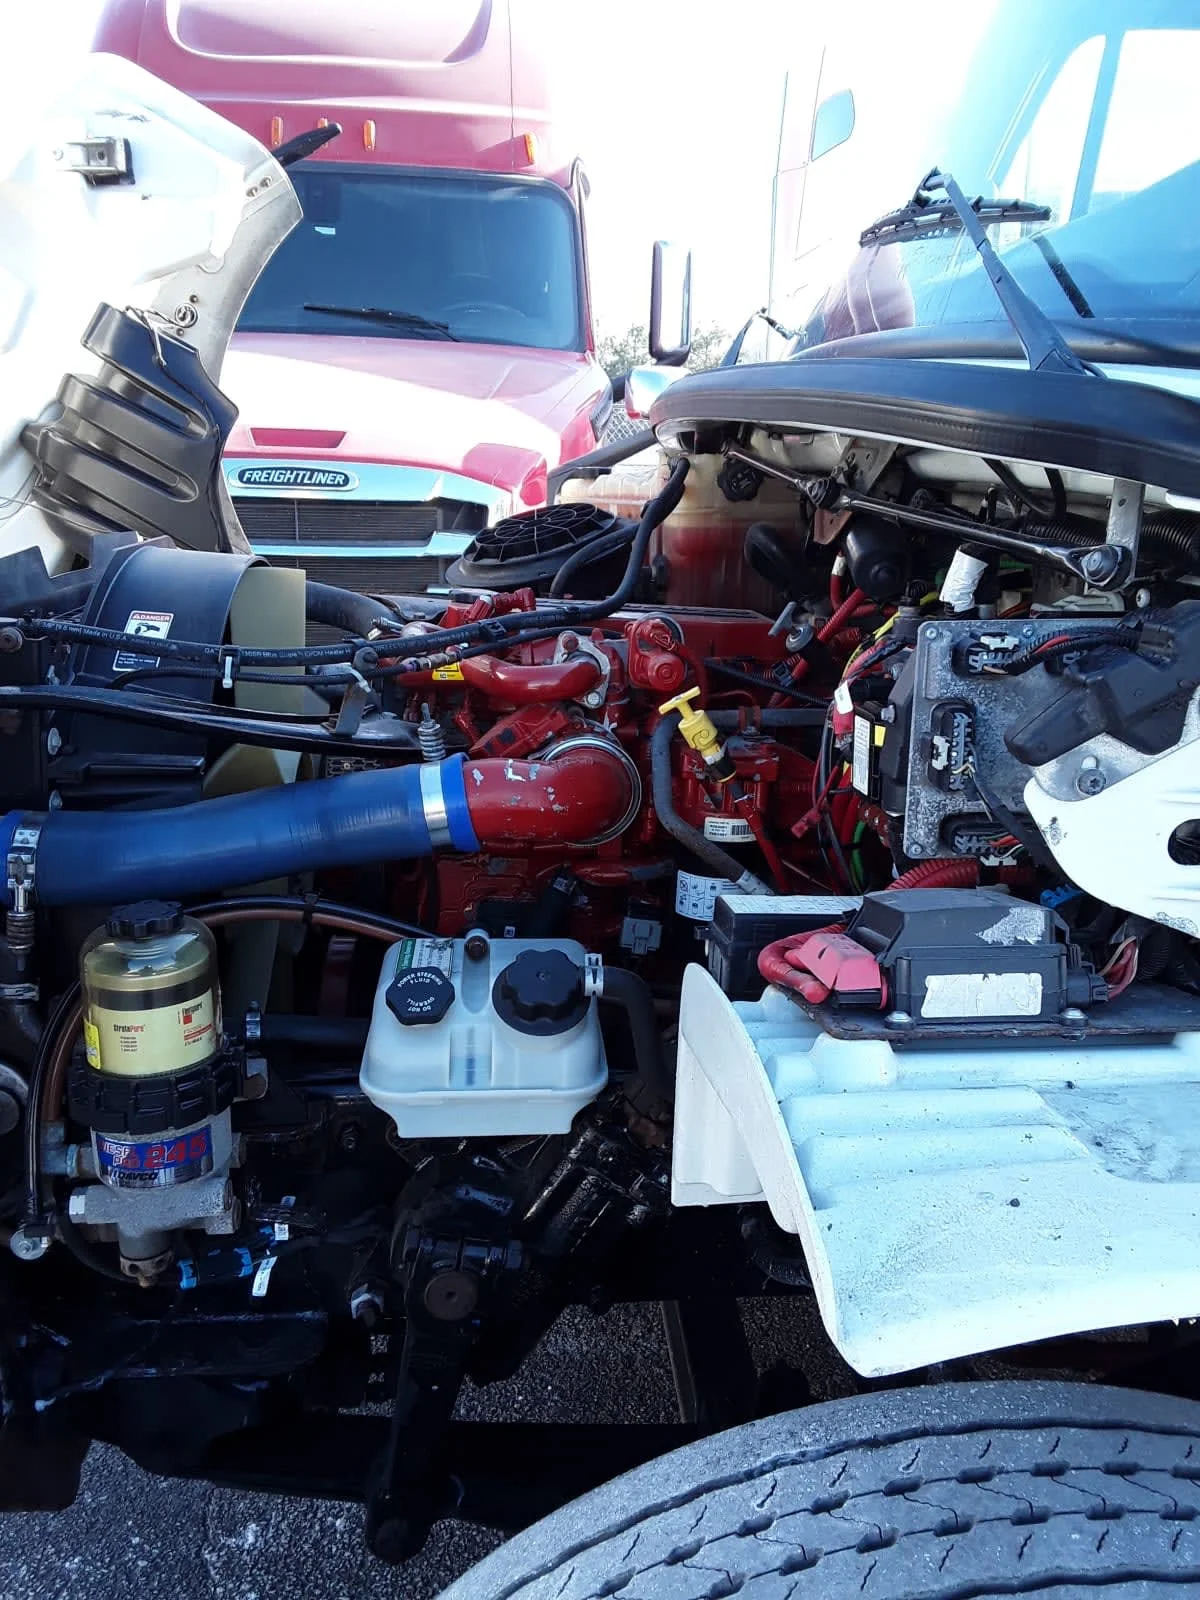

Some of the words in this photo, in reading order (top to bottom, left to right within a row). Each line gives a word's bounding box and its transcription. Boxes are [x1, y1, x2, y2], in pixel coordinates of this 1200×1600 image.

[243, 470, 345, 485] FREIGHTLINER
[397, 973, 415, 987] POWER
[417, 972, 443, 985] STEERING
[406, 997, 435, 1007] OVERFILL
[144, 1134, 207, 1168] 245
